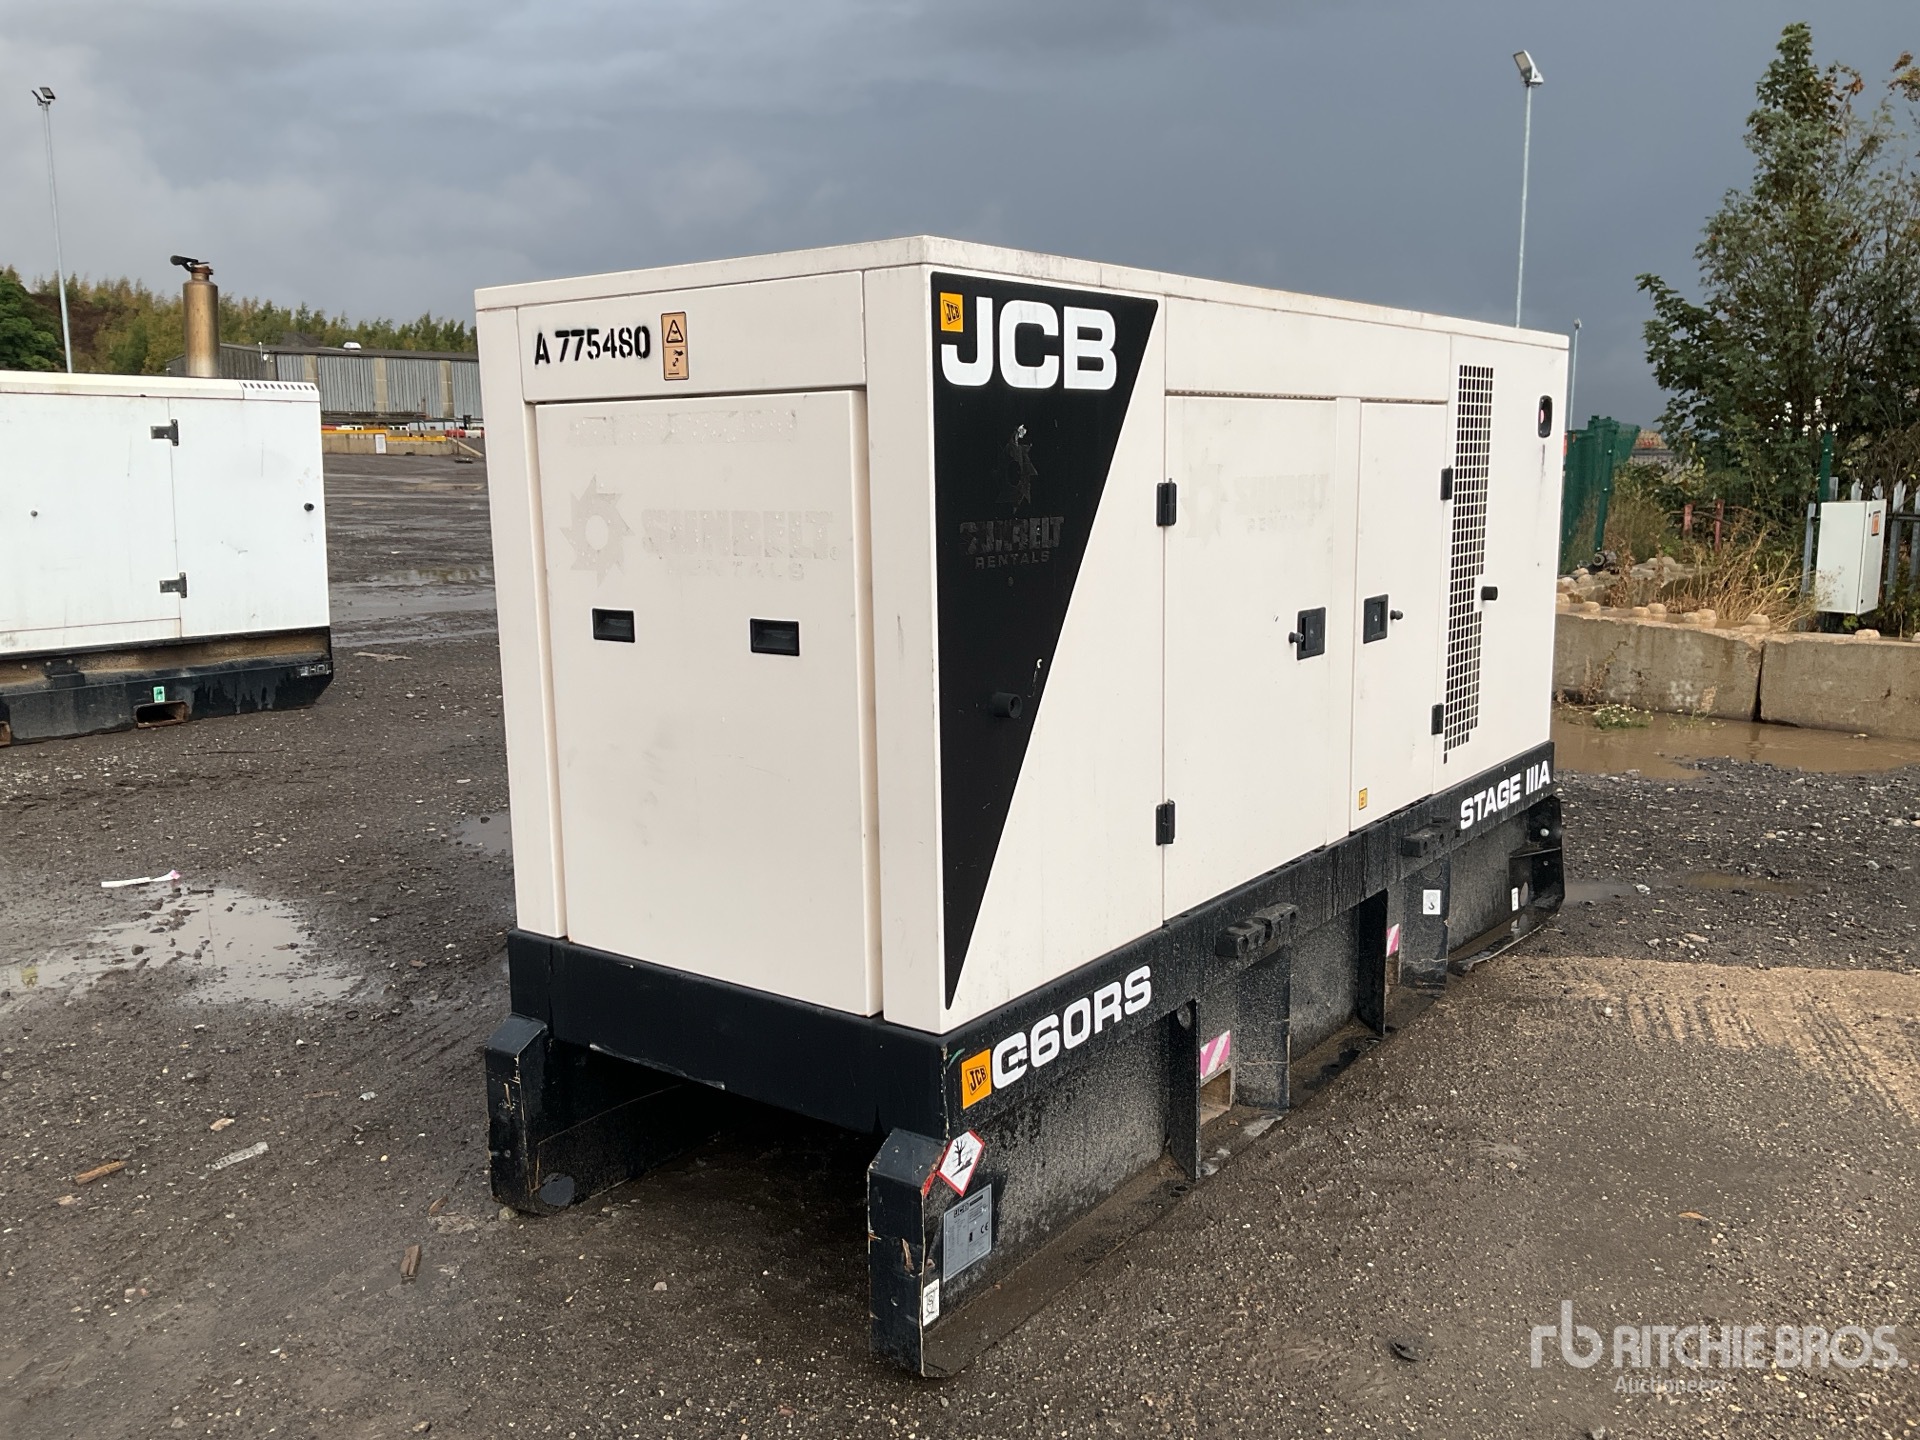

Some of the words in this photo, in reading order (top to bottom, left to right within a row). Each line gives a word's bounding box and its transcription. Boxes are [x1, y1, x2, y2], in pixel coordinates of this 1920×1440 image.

[534, 332, 551, 365] A
[941, 296, 1117, 390] JCB
[975, 550, 1050, 570] RENTALS
[1460, 773, 1521, 830] STAGE
[1525, 760, 1551, 795] IIIA
[992, 965, 1151, 1089] G60RS
[968, 1065, 988, 1092] JCB
